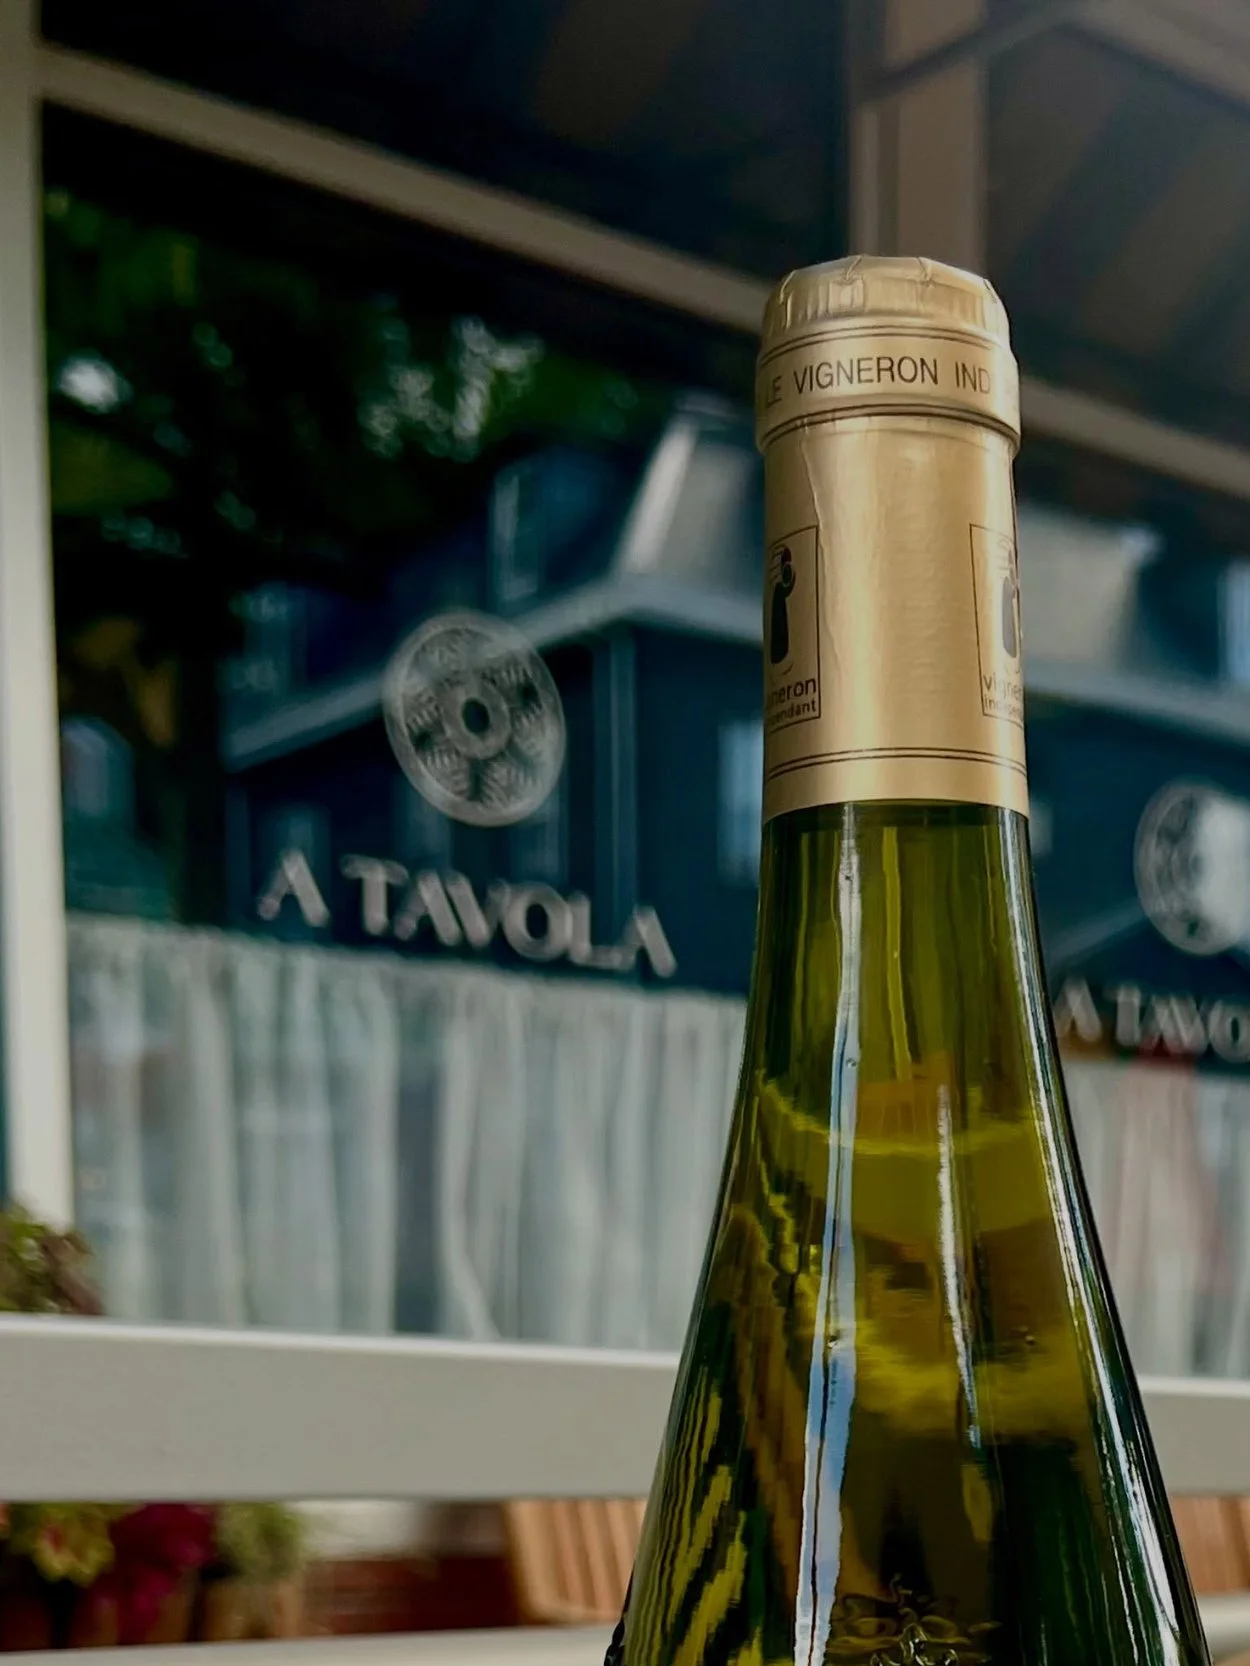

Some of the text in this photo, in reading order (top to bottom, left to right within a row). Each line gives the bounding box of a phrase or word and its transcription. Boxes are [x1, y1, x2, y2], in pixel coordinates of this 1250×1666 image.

[793, 356, 939, 395] VIGNERON
[256, 847, 677, 978] A TAVOLA
